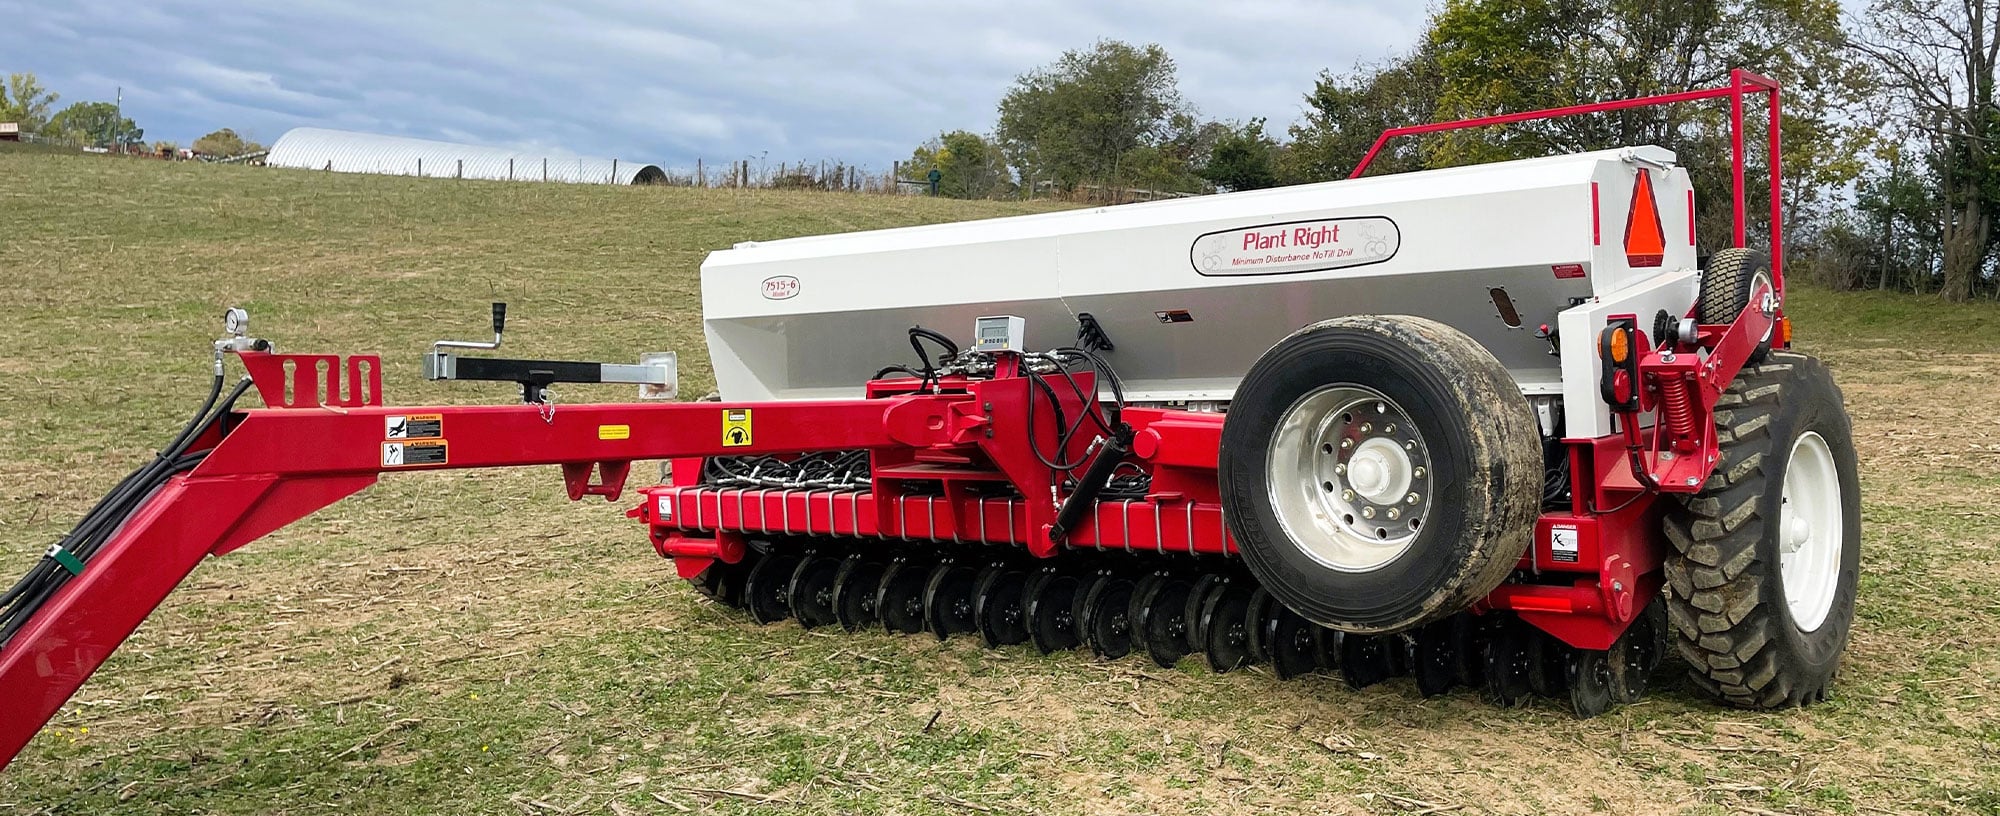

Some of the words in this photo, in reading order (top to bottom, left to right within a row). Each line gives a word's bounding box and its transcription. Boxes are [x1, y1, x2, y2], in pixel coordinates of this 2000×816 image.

[1243, 230, 1286, 250] Plant
[1293, 225, 1339, 248] Right
[1265, 254, 1310, 264] Disturbance
[1337, 248, 1353, 257] Drill
[766, 280, 796, 291] 7515-6
